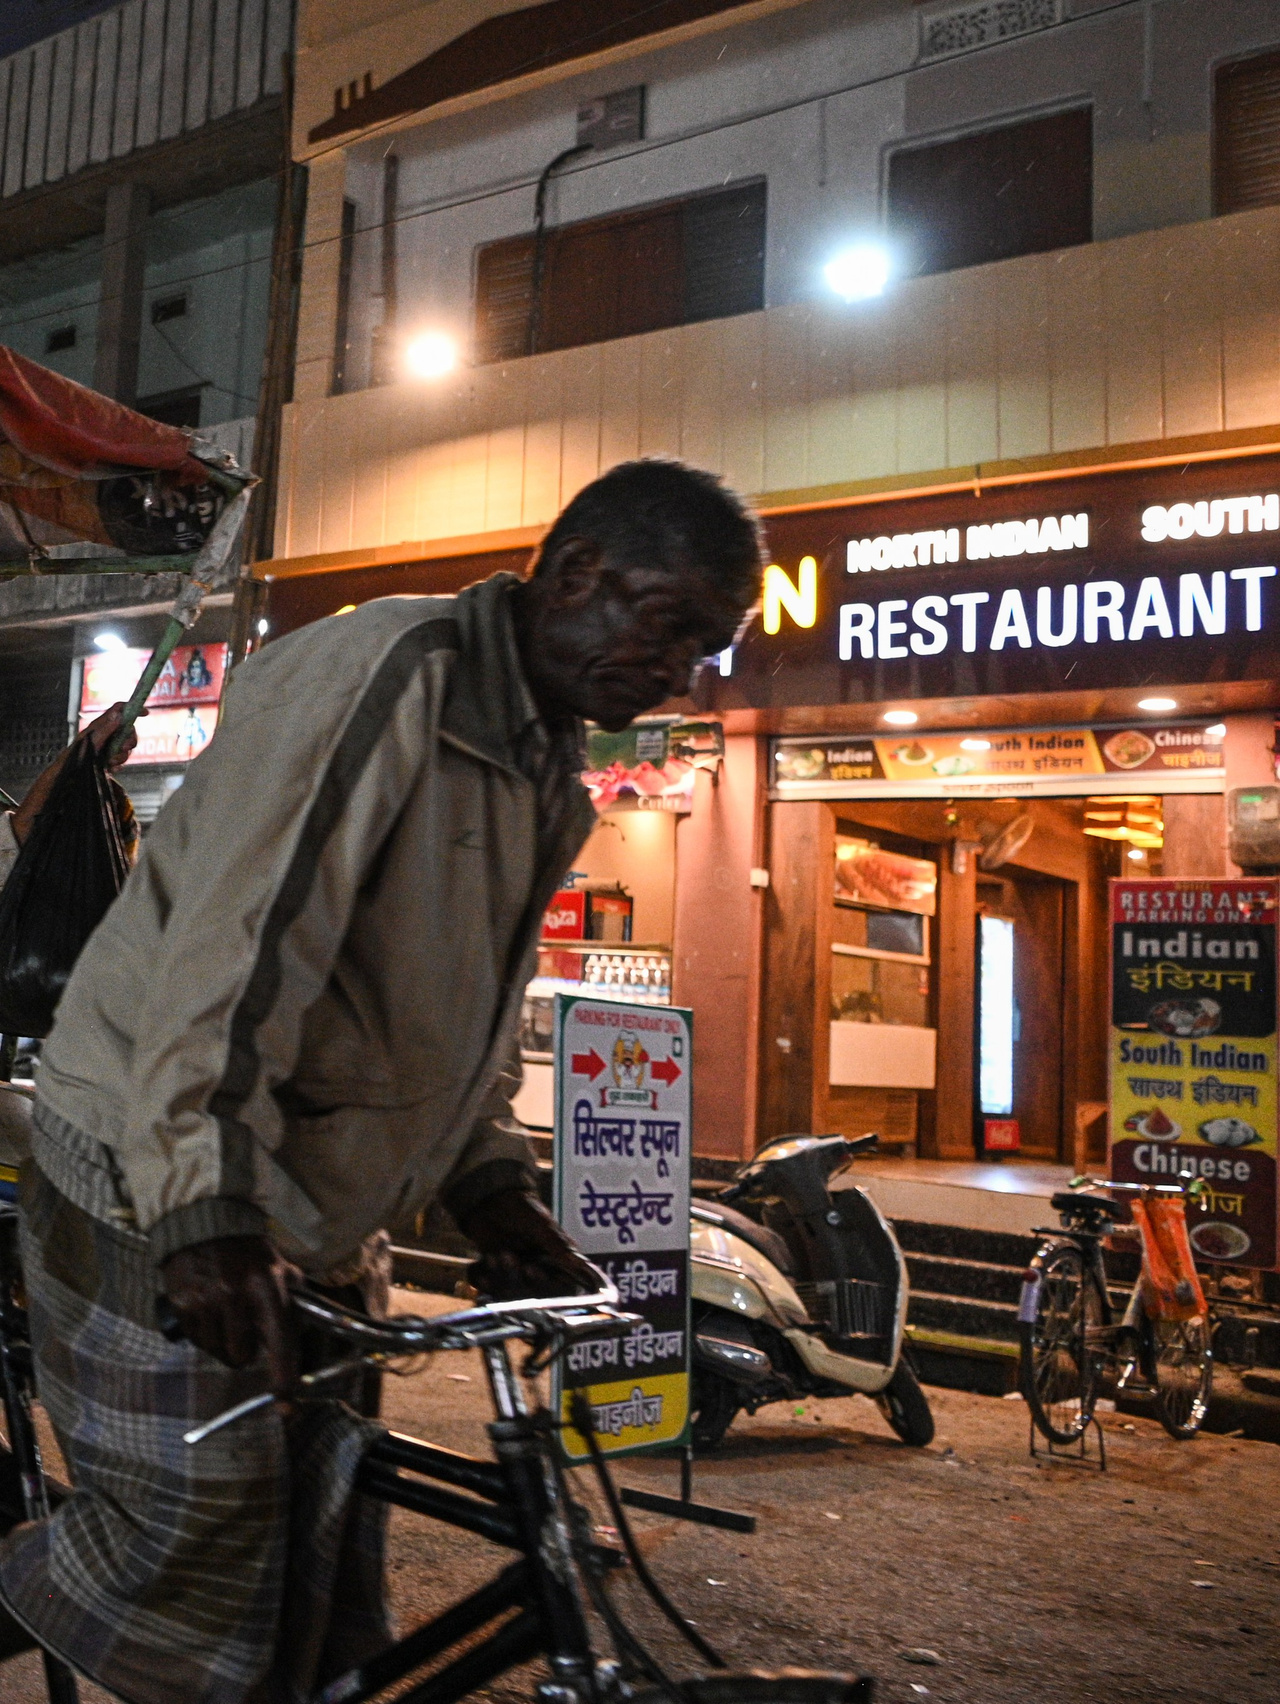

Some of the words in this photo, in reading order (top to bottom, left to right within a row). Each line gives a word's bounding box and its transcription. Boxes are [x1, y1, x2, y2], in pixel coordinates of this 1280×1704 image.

[847, 528, 959, 573] NORTH
[966, 513, 1089, 560] INDIAN
[1141, 493, 1280, 543] SOUTH
[839, 566, 1277, 661] RESTAURANT
[1028, 735, 1085, 751] Indian
[1126, 908, 1207, 923] PARKING
[1123, 931, 1259, 960] Indian
[1127, 961, 1255, 993] इंडियन
[1120, 1038, 1182, 1068] South
[1191, 1042, 1267, 1072] Indian
[1127, 1077, 1183, 1101] साउथ
[1191, 1074, 1258, 1108] इंडियन
[573, 1098, 637, 1157] सिल्वर
[639, 1119, 681, 1178] स्पून
[1132, 1143, 1251, 1182] Chinese
[579, 1180, 674, 1244] रेस्टूरेन्ट
[618, 1259, 678, 1304] इंडियन
[623, 1322, 684, 1368] इंडियन
